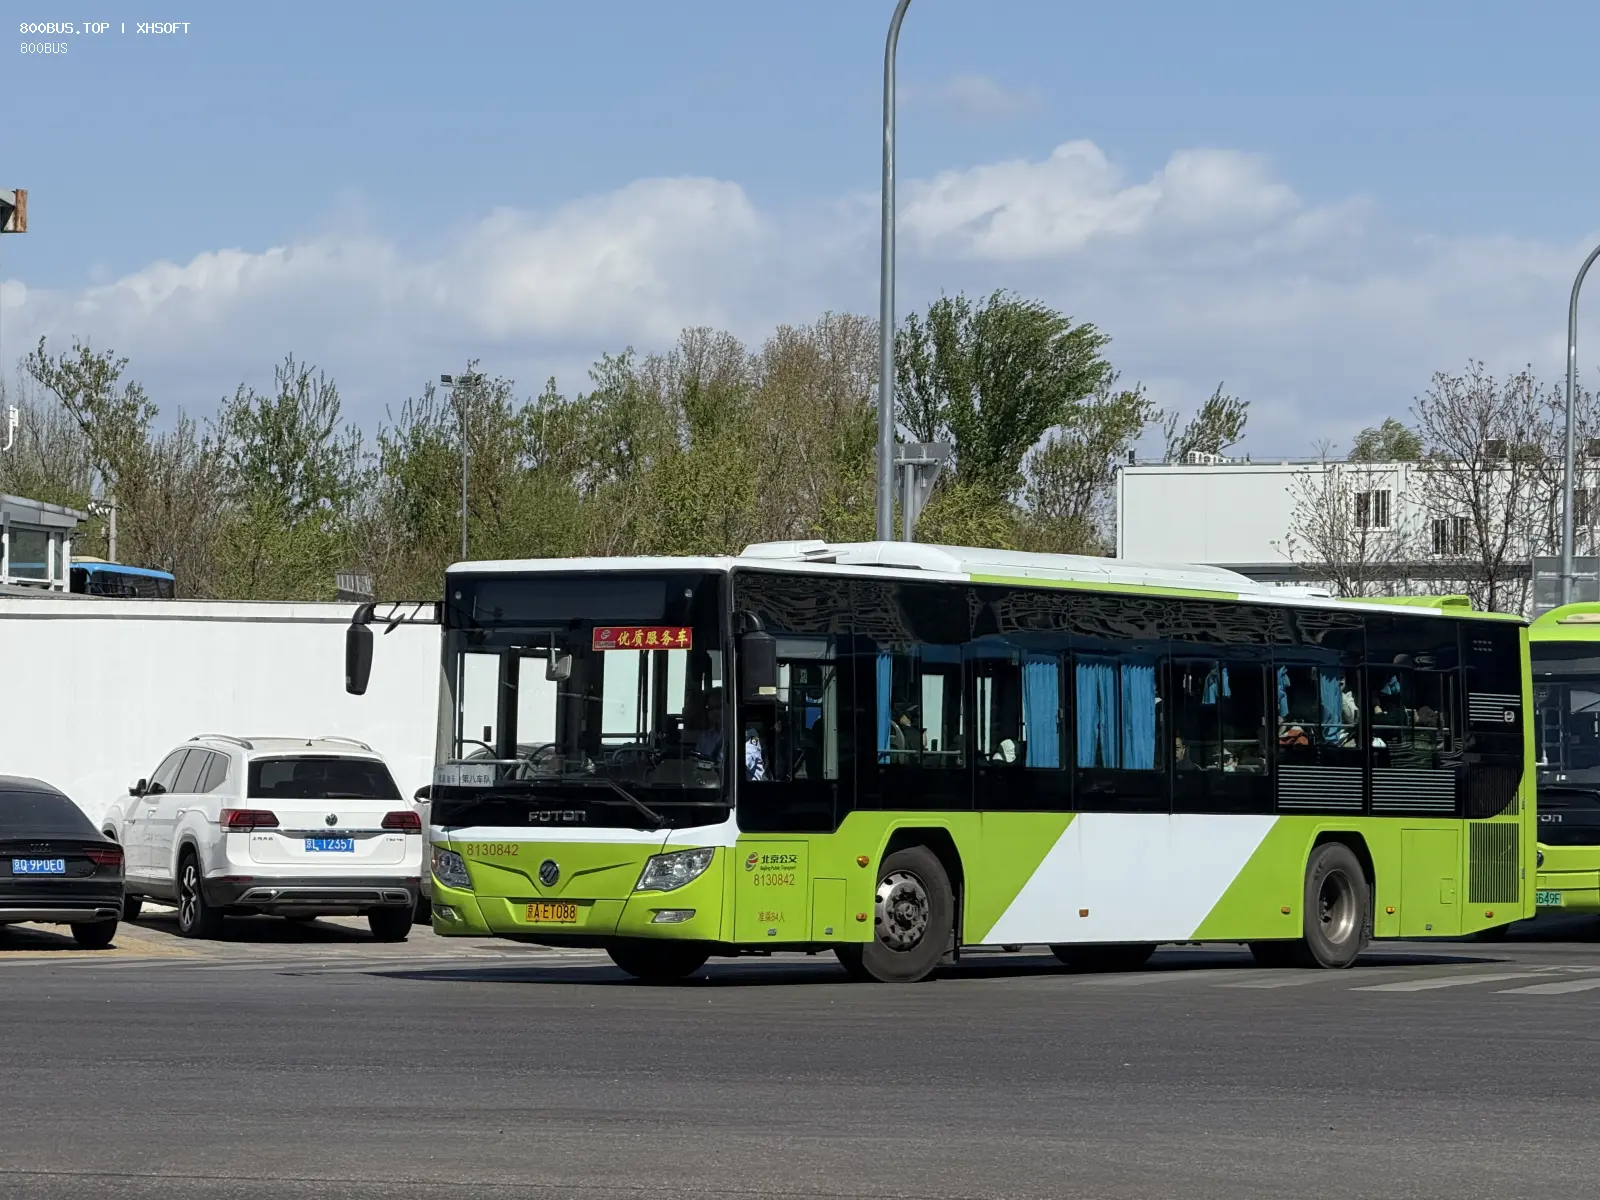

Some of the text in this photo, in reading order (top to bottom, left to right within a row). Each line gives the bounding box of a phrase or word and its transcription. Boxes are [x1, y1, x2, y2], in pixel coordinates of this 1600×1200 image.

[617, 628, 689, 647] 优质服务车
[461, 773, 492, 784] 第八车队
[466, 844, 519, 856] 8130842
[761, 854, 798, 864] 北京公交
[754, 873, 795, 887] 8130842
